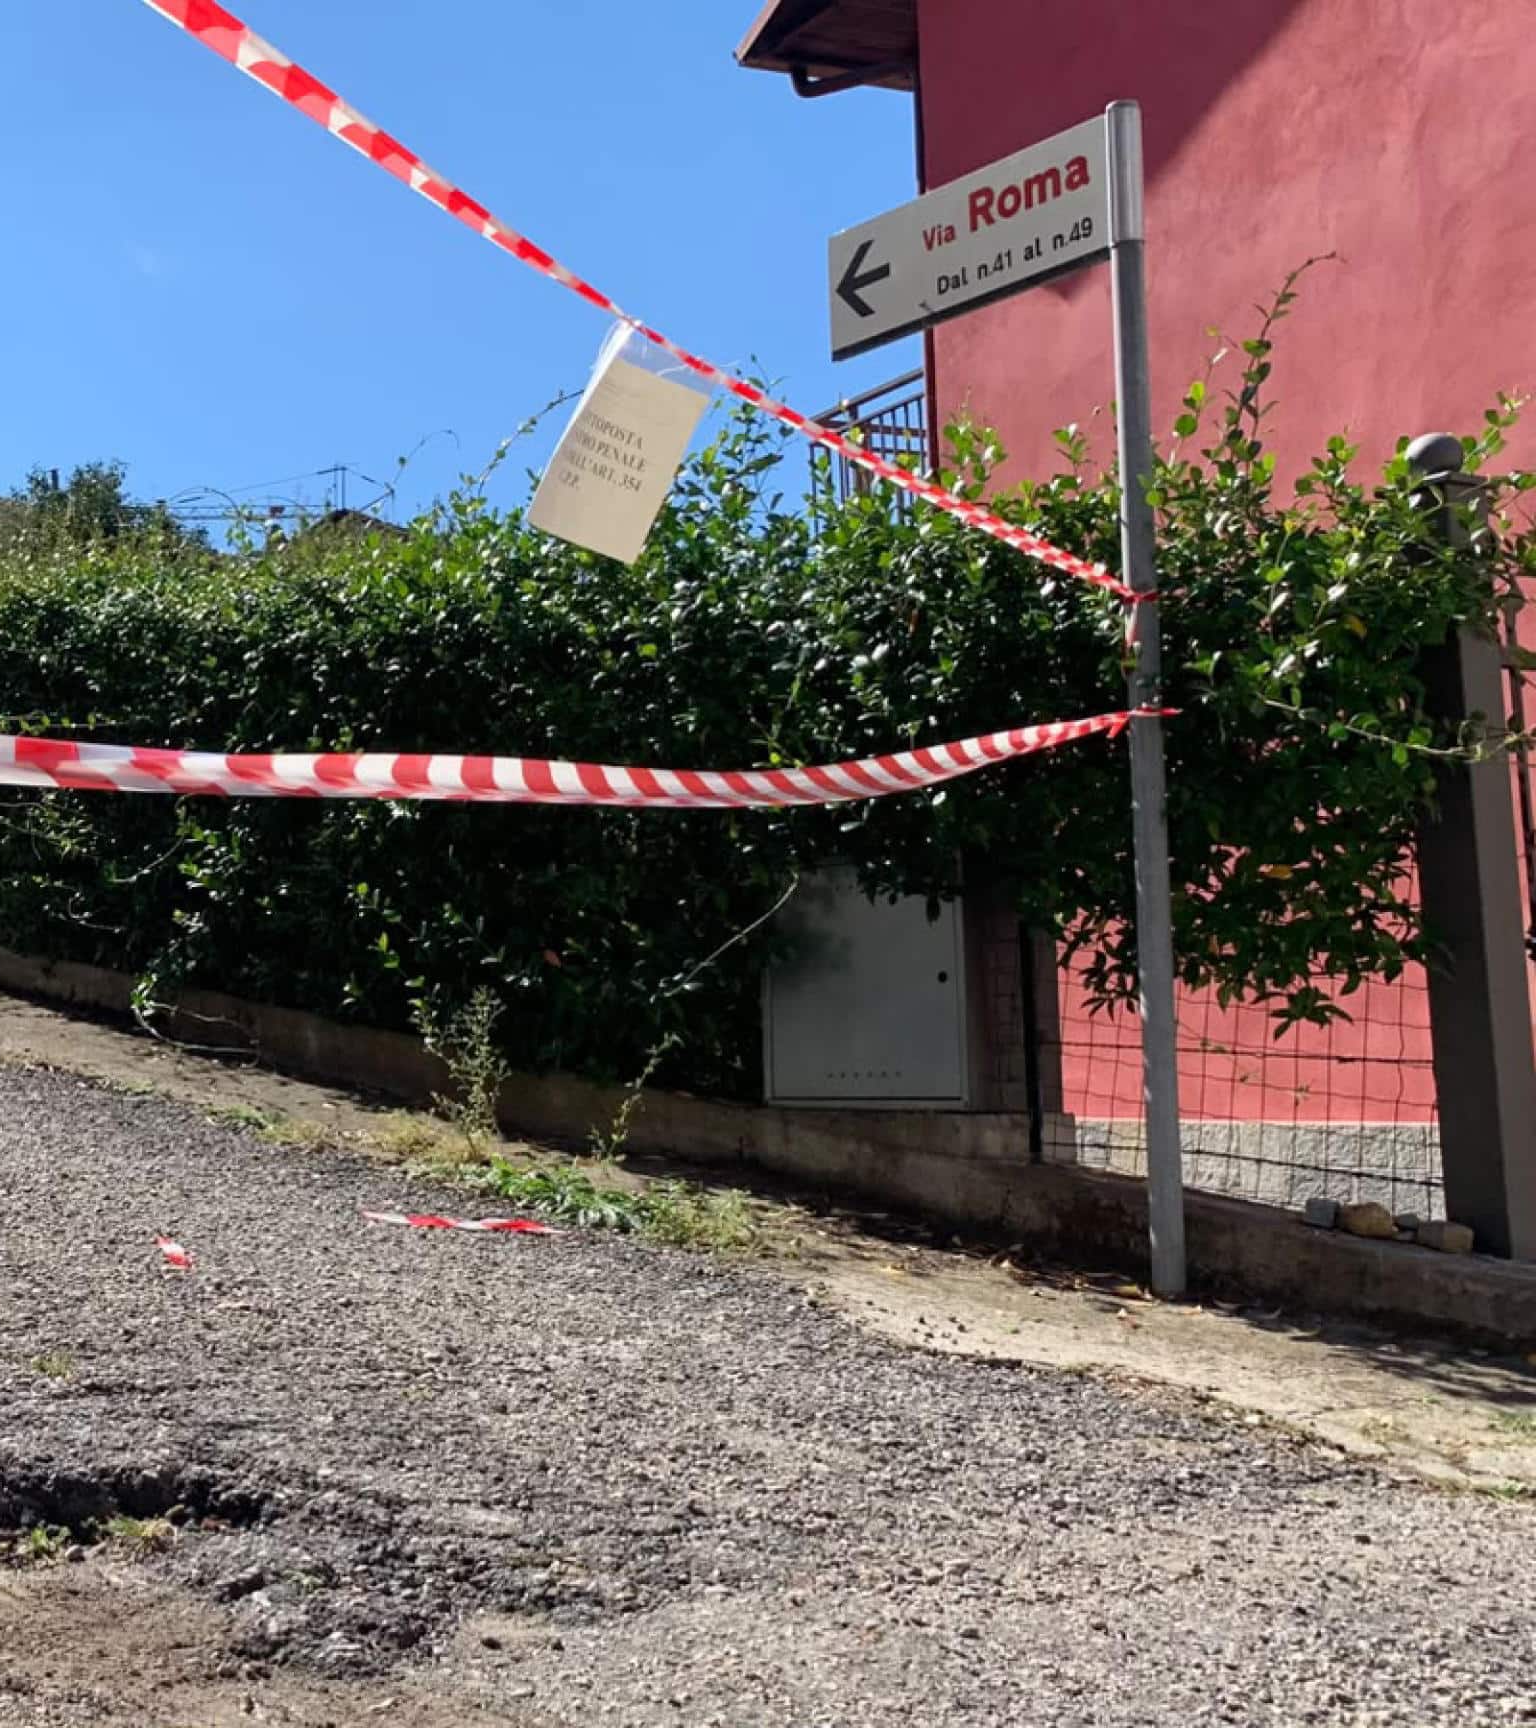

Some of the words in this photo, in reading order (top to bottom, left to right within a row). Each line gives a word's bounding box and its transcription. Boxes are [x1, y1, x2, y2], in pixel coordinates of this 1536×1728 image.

[922, 222, 957, 252] Via
[967, 154, 1091, 233] Roma
[936, 266, 969, 296] Dal
[976, 249, 1014, 281] n.41
[1023, 237, 1044, 263] al
[1052, 216, 1094, 251] n.49
